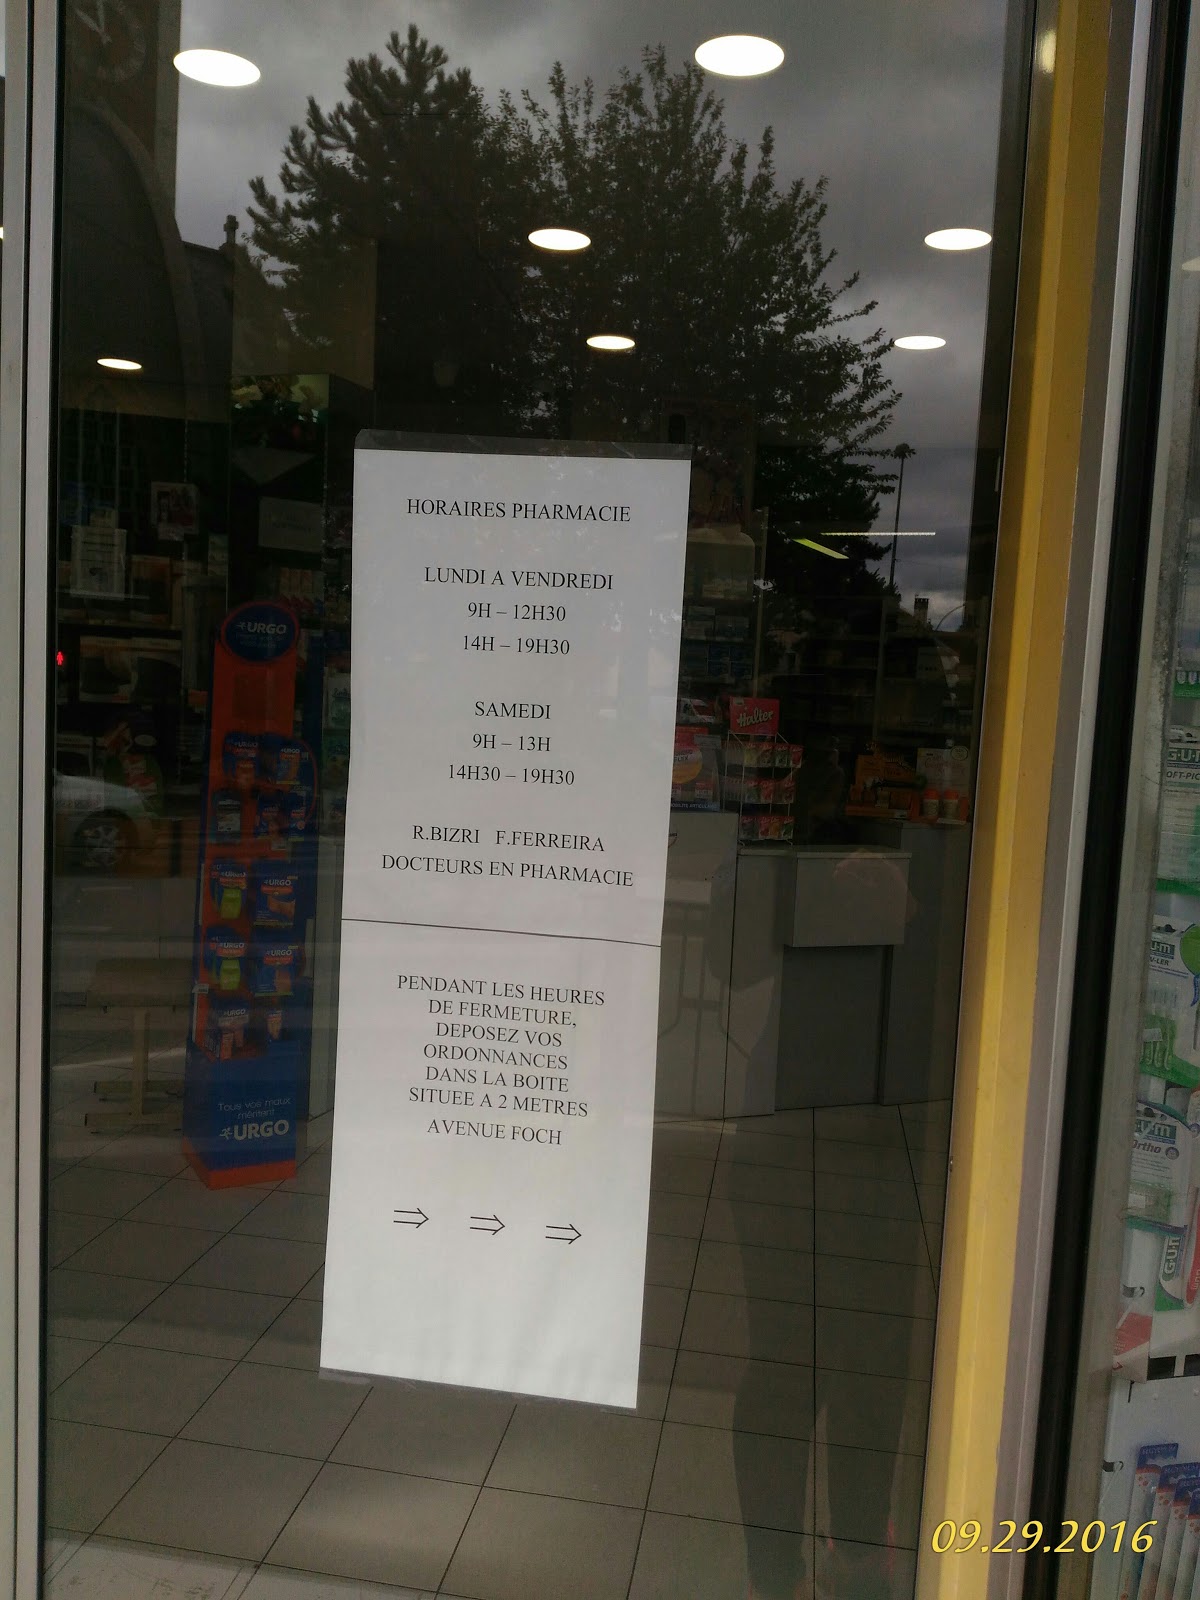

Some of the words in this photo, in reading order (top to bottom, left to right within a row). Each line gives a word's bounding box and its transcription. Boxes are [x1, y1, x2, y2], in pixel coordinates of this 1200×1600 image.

[407, 499, 505, 518] HORAIRES
[512, 503, 630, 521] PHARMACIE
[425, 567, 485, 584] LUNDI
[491, 570, 504, 585] A
[511, 571, 613, 589] VENDREDI
[468, 602, 491, 618] 9H
[513, 605, 565, 621] 12H30
[246, 622, 287, 635] URGO
[463, 635, 494, 651] 14H
[517, 638, 569, 654] 19H30
[475, 701, 551, 719] SAMEDI
[737, 707, 774, 727] Halter
[473, 734, 496, 749] 9H
[518, 736, 550, 751] 13H
[449, 765, 500, 781] 14H30
[522, 768, 574, 785] 19H30
[412, 825, 479, 843] R.BIZRI
[496, 831, 604, 851] F.FERREIRA
[382, 855, 482, 875] DOCTEURS
[489, 862, 514, 876] EN
[520, 863, 633, 886] PHARMACIE
[270, 949, 292, 957] URGO
[398, 975, 487, 994] PENDANT
[493, 982, 524, 998] LES
[531, 986, 604, 1005] HEURES
[429, 999, 453, 1014] DE
[459, 1002, 576, 1028] FERMETURE,
[436, 1022, 519, 1043] DEPOSEZ
[525, 1031, 561, 1047] VOS
[424, 1044, 567, 1070] ORDONNANCES
[426, 1066, 476, 1083] DANS
[483, 1071, 507, 1086] LA
[513, 1074, 568, 1092] BOITE
[218, 1102, 241, 1112] Tous
[245, 1101, 261, 1109] vos
[265, 1097, 291, 1106] maux
[410, 1087, 474, 1106] SITUEE
[480, 1093, 492, 1107] A
[498, 1095, 507, 1108] 2
[513, 1096, 587, 1117] METRES
[234, 1119, 290, 1140] URGO
[427, 1119, 505, 1139] AVENUE
[512, 1126, 562, 1145] FOCH
